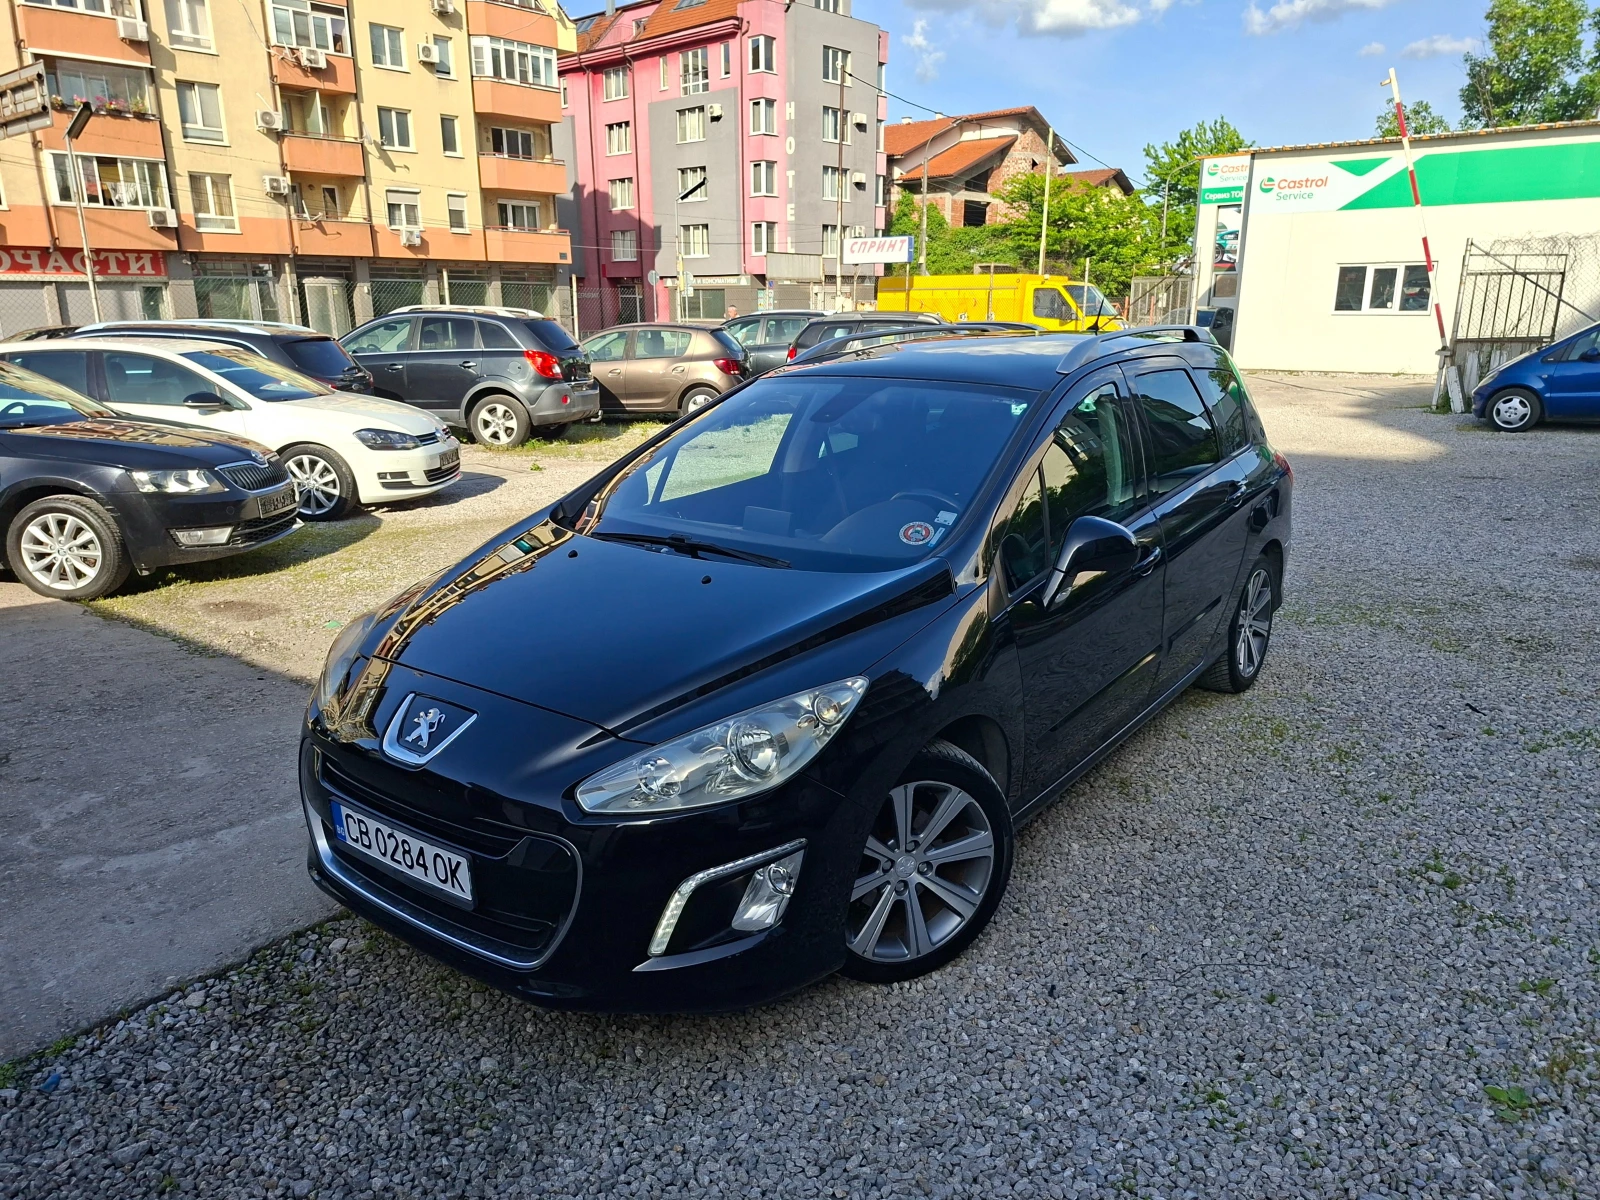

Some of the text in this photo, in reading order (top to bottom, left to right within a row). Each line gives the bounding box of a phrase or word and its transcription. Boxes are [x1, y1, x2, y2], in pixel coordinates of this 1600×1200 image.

[785, 101, 796, 253] HOTEL
[1277, 176, 1329, 190] Castrol
[1275, 191, 1314, 201] Service
[850, 239, 907, 254] СПРИНТ
[344, 812, 466, 893] CB 0284 OK
